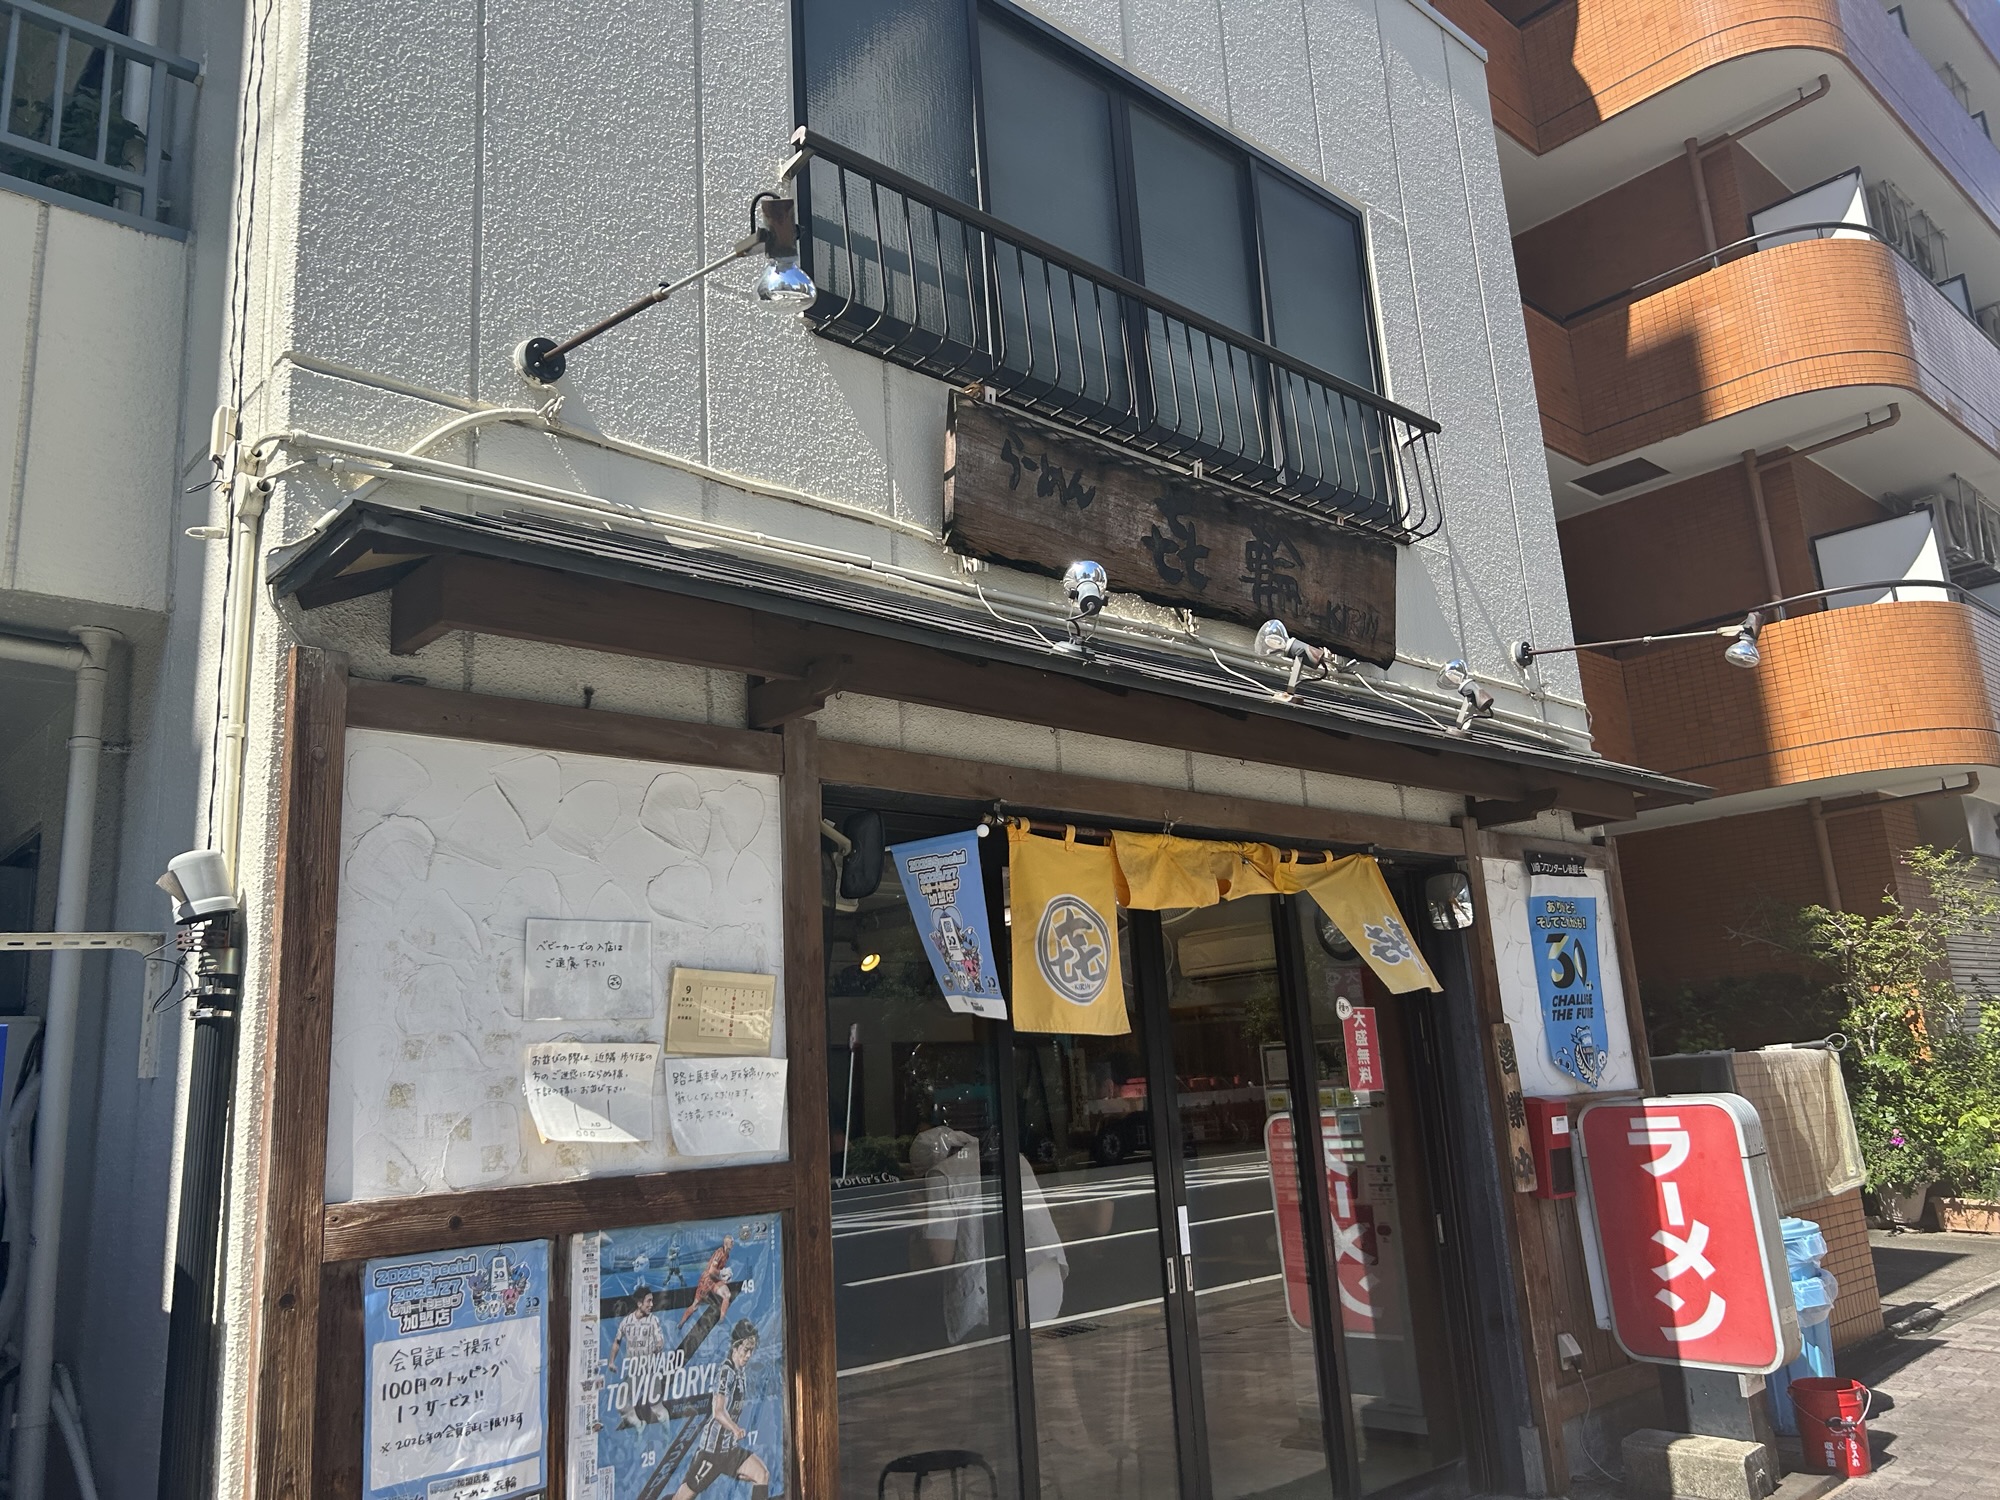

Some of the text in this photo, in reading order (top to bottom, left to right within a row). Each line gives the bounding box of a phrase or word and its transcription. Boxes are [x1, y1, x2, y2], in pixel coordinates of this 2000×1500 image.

[685, 985, 692, 995] 9
[1552, 1009, 1573, 1021] THE
[1352, 1010, 1373, 1085] 大盛無料
[835, 1174, 880, 1189] Porter's
[1626, 1115, 1727, 1342] ラーメン
[392, 1279, 462, 1303] 2026/27
[741, 1280, 755, 1294] 49
[402, 1310, 451, 1333] 加盟店
[620, 1349, 685, 1380] FORWARD
[607, 1362, 717, 1412] TO VICTORY!
[747, 1430, 759, 1446] 17
[641, 1450, 656, 1468] 29
[698, 1460, 714, 1478] 17
